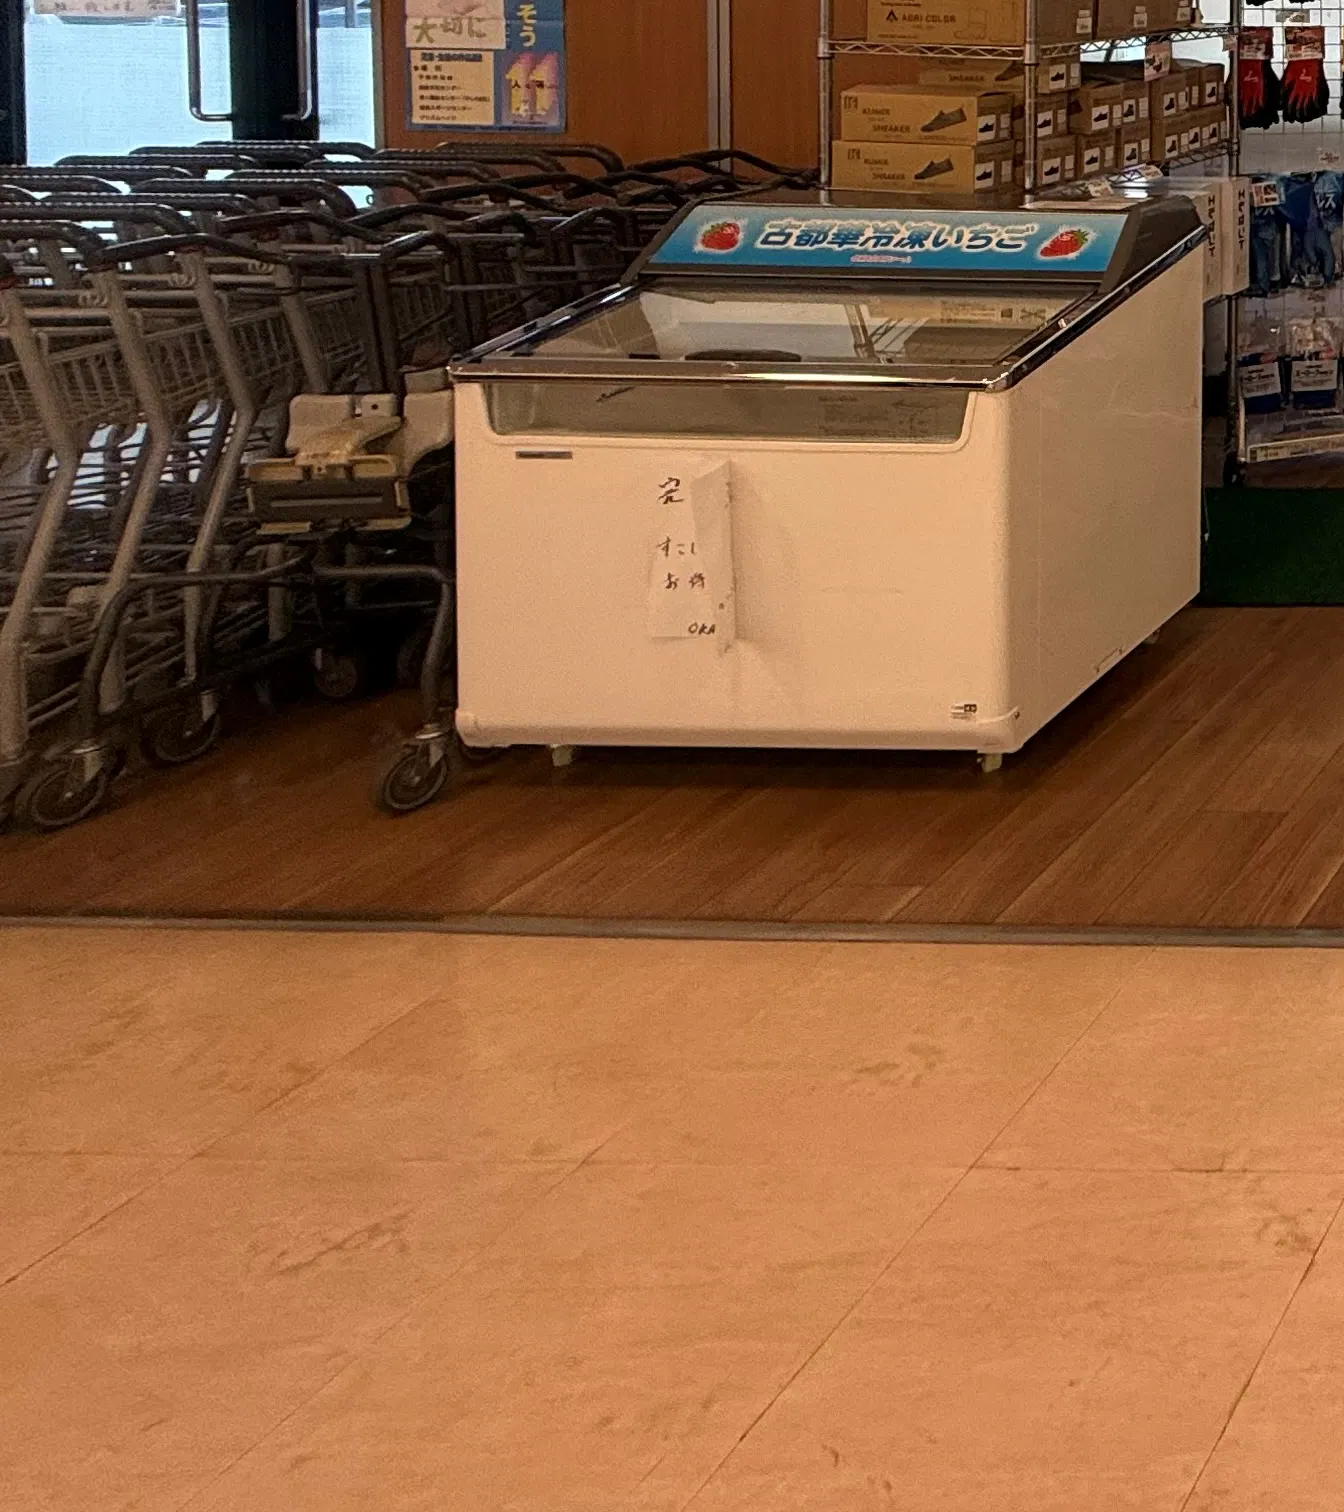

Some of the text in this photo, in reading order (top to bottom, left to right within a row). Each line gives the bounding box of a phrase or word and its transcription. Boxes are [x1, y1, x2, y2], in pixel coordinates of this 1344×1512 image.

[412, 15, 487, 44] 大切に
[758, 220, 1038, 250] 古都華冷凍いちご
